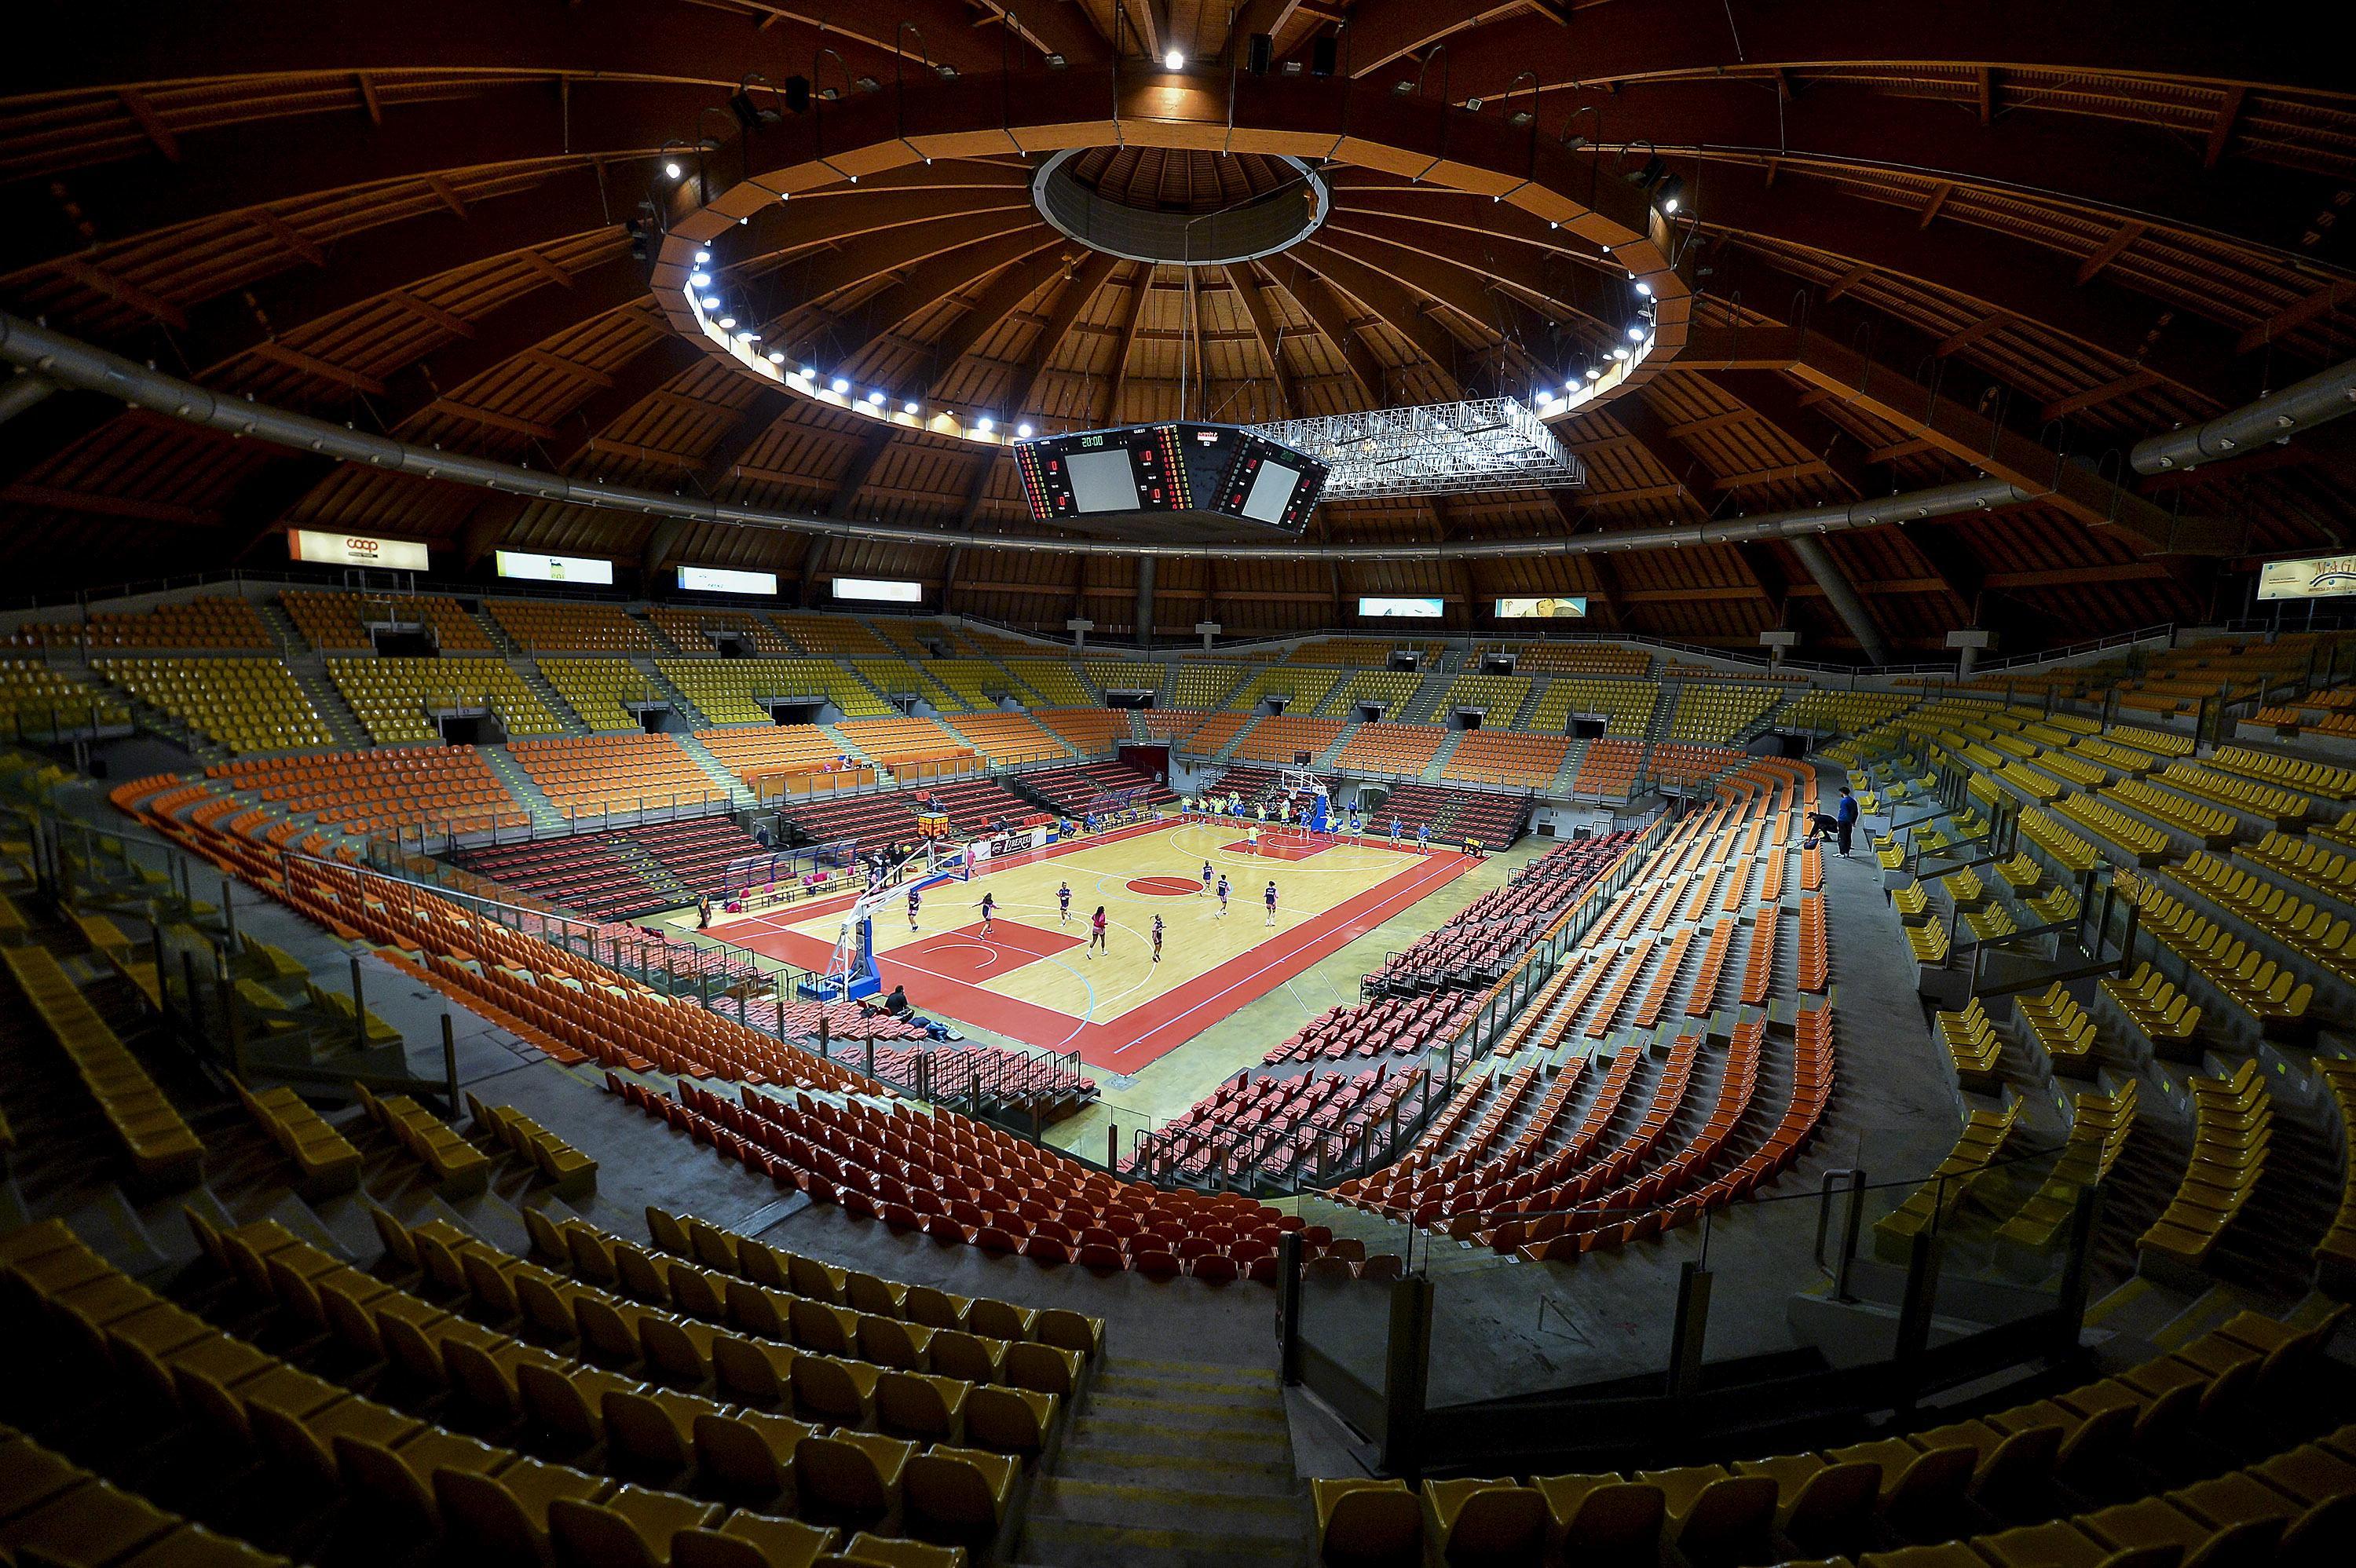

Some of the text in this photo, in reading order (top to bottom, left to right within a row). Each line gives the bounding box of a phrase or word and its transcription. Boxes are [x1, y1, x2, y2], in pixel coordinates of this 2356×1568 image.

[1081, 436, 1103, 448] 20:00
[1146, 451, 1151, 461] 0
[1052, 461, 1057, 470] 0
[1154, 488, 1160, 499] 0
[1059, 496, 1065, 506] 0
[346, 539, 379, 553] coop
[918, 823, 932, 836] 24
[933, 823, 948, 836] 24
[1003, 835, 1031, 853] LIBERTAS
